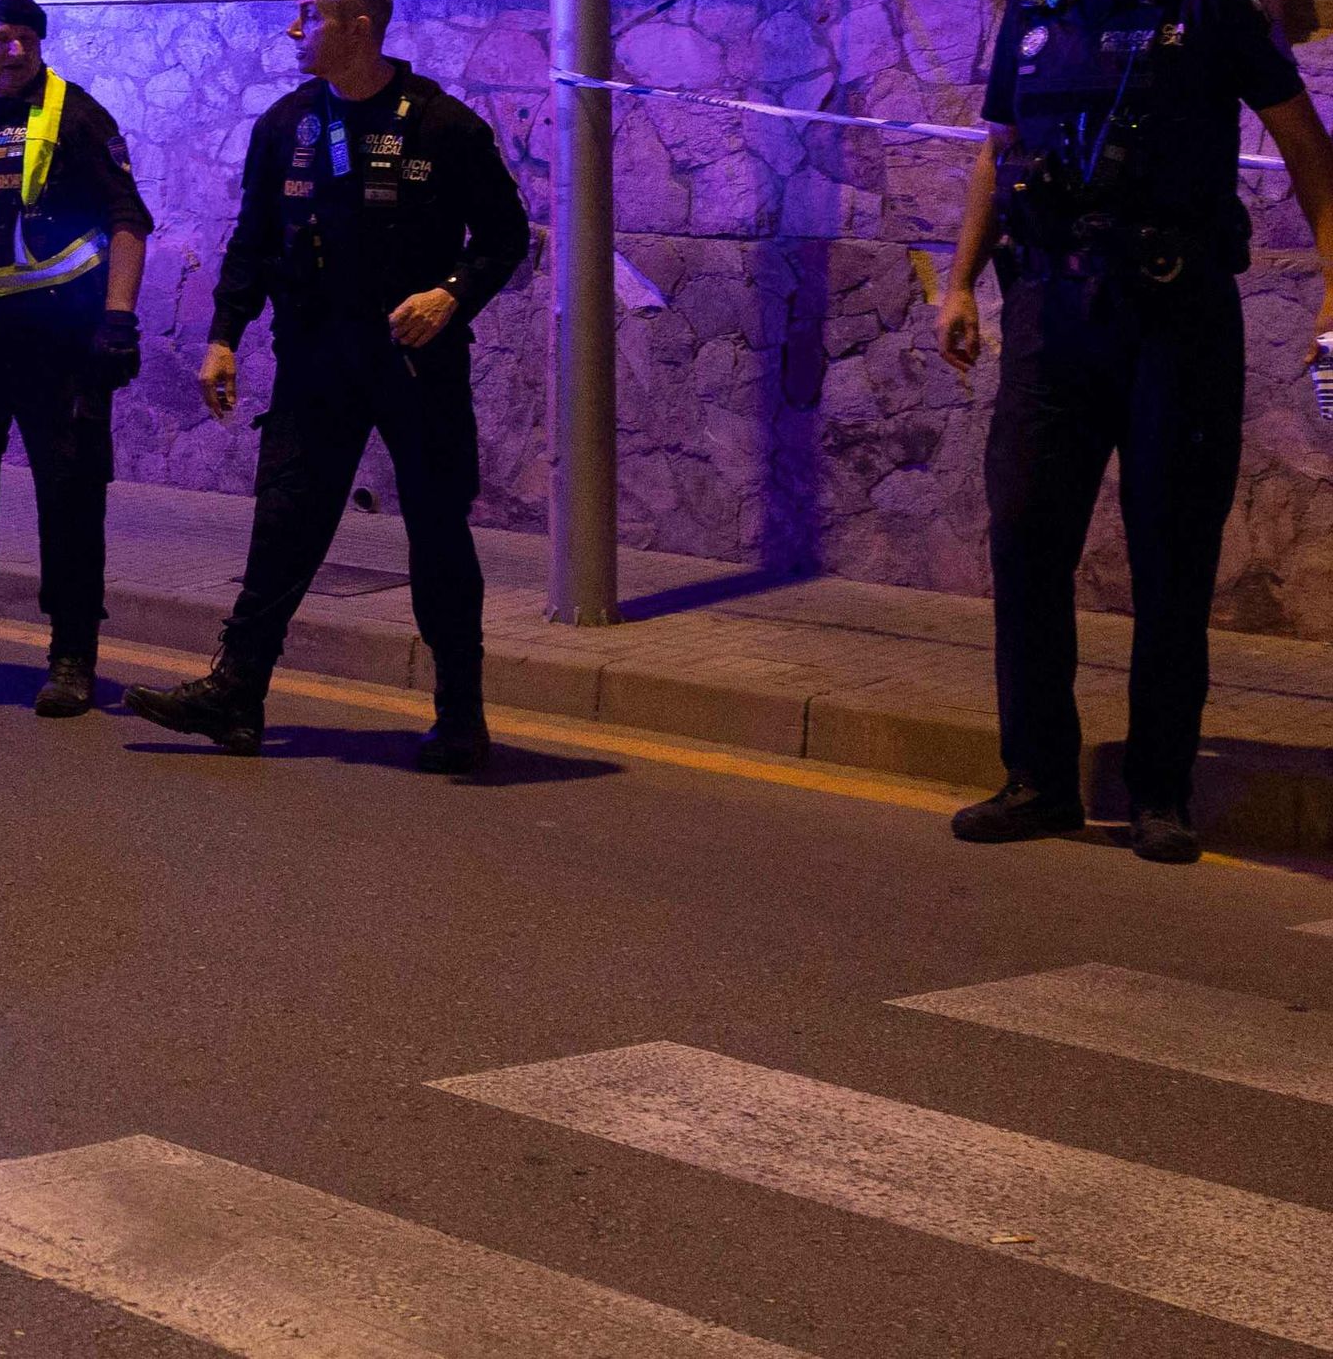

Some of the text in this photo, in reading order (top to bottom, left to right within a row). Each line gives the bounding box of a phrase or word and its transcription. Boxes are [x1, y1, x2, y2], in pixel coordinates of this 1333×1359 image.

[365, 134, 403, 145] OLICIA
[402, 159, 432, 171] LICIA
[402, 169, 429, 182] OCAL
